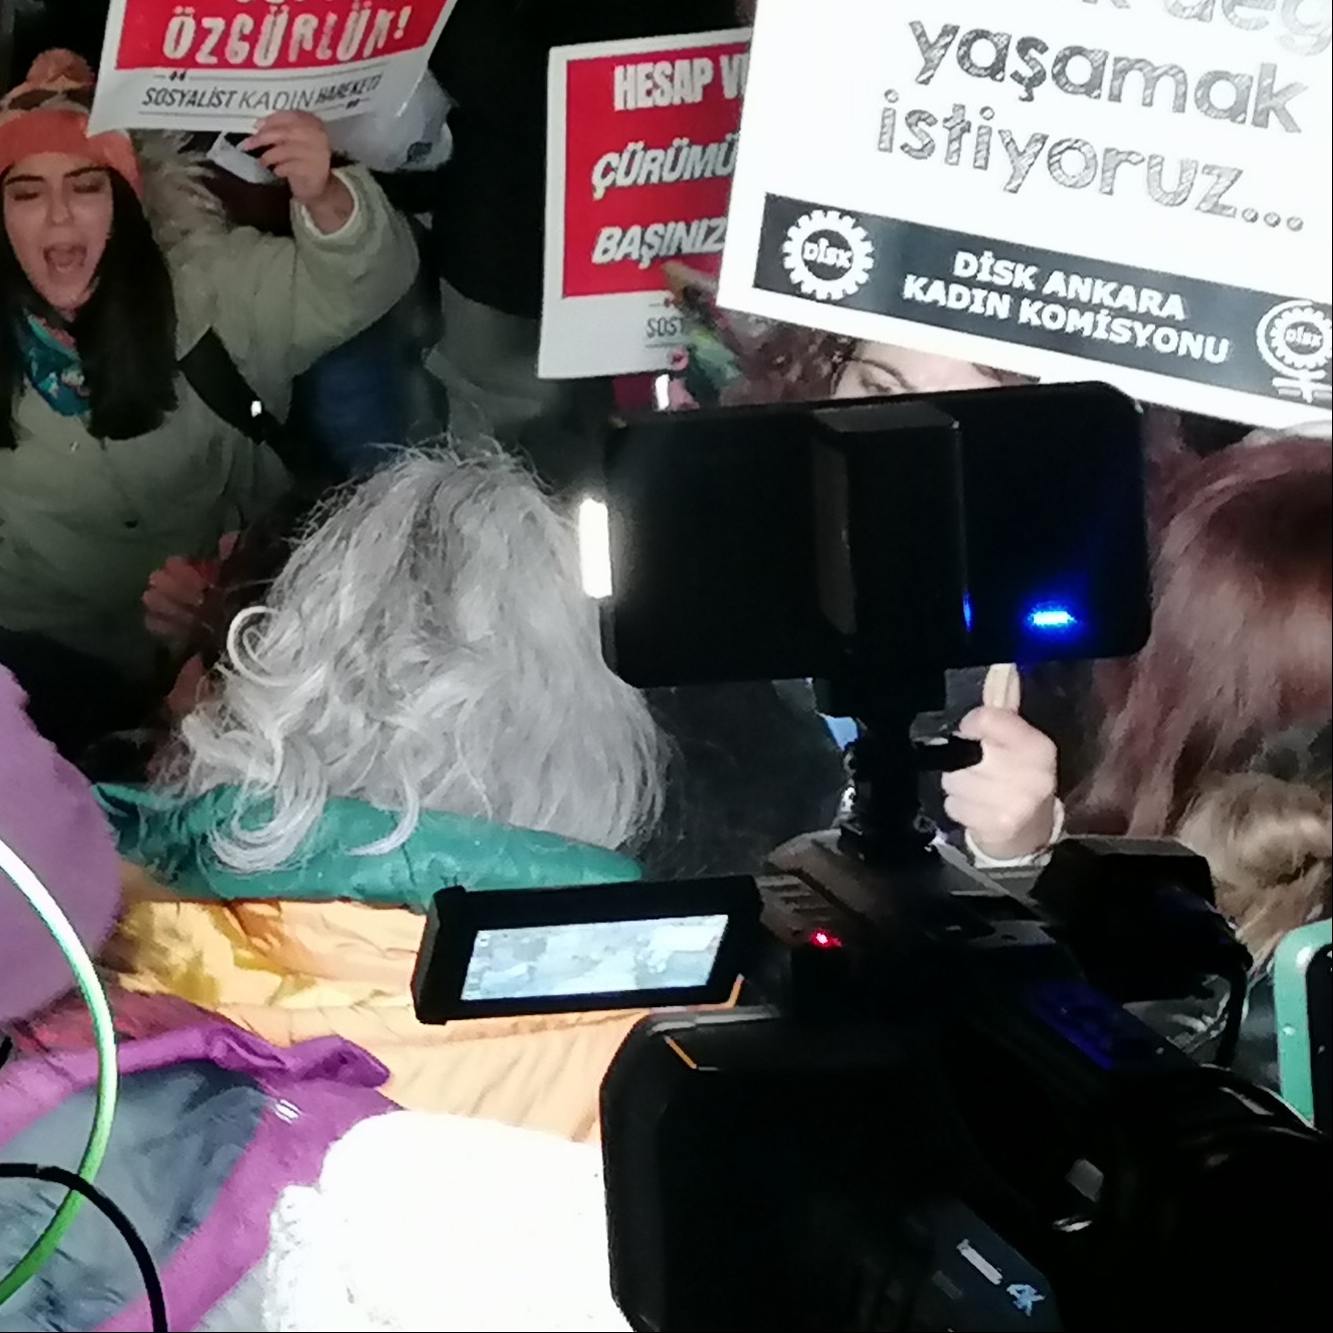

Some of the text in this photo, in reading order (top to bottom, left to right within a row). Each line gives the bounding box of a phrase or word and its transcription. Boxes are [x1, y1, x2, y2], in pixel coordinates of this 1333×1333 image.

[162, 1, 412, 67] ÖZGÜRLÜK!
[141, 86, 238, 109] SOSYALİST
[238, 90, 317, 110] KADIN
[614, 58, 714, 111] HESAP
[908, 19, 1309, 135] yaşamak
[592, 133, 738, 201] ÇÜRÜMÜ
[877, 89, 1304, 233] istiyoruz...
[592, 217, 727, 269] BAŞINIZ
[902, 273, 1231, 365] KADIN KOMİSYONU
[954, 249, 1188, 322] DİSK ANKARA
